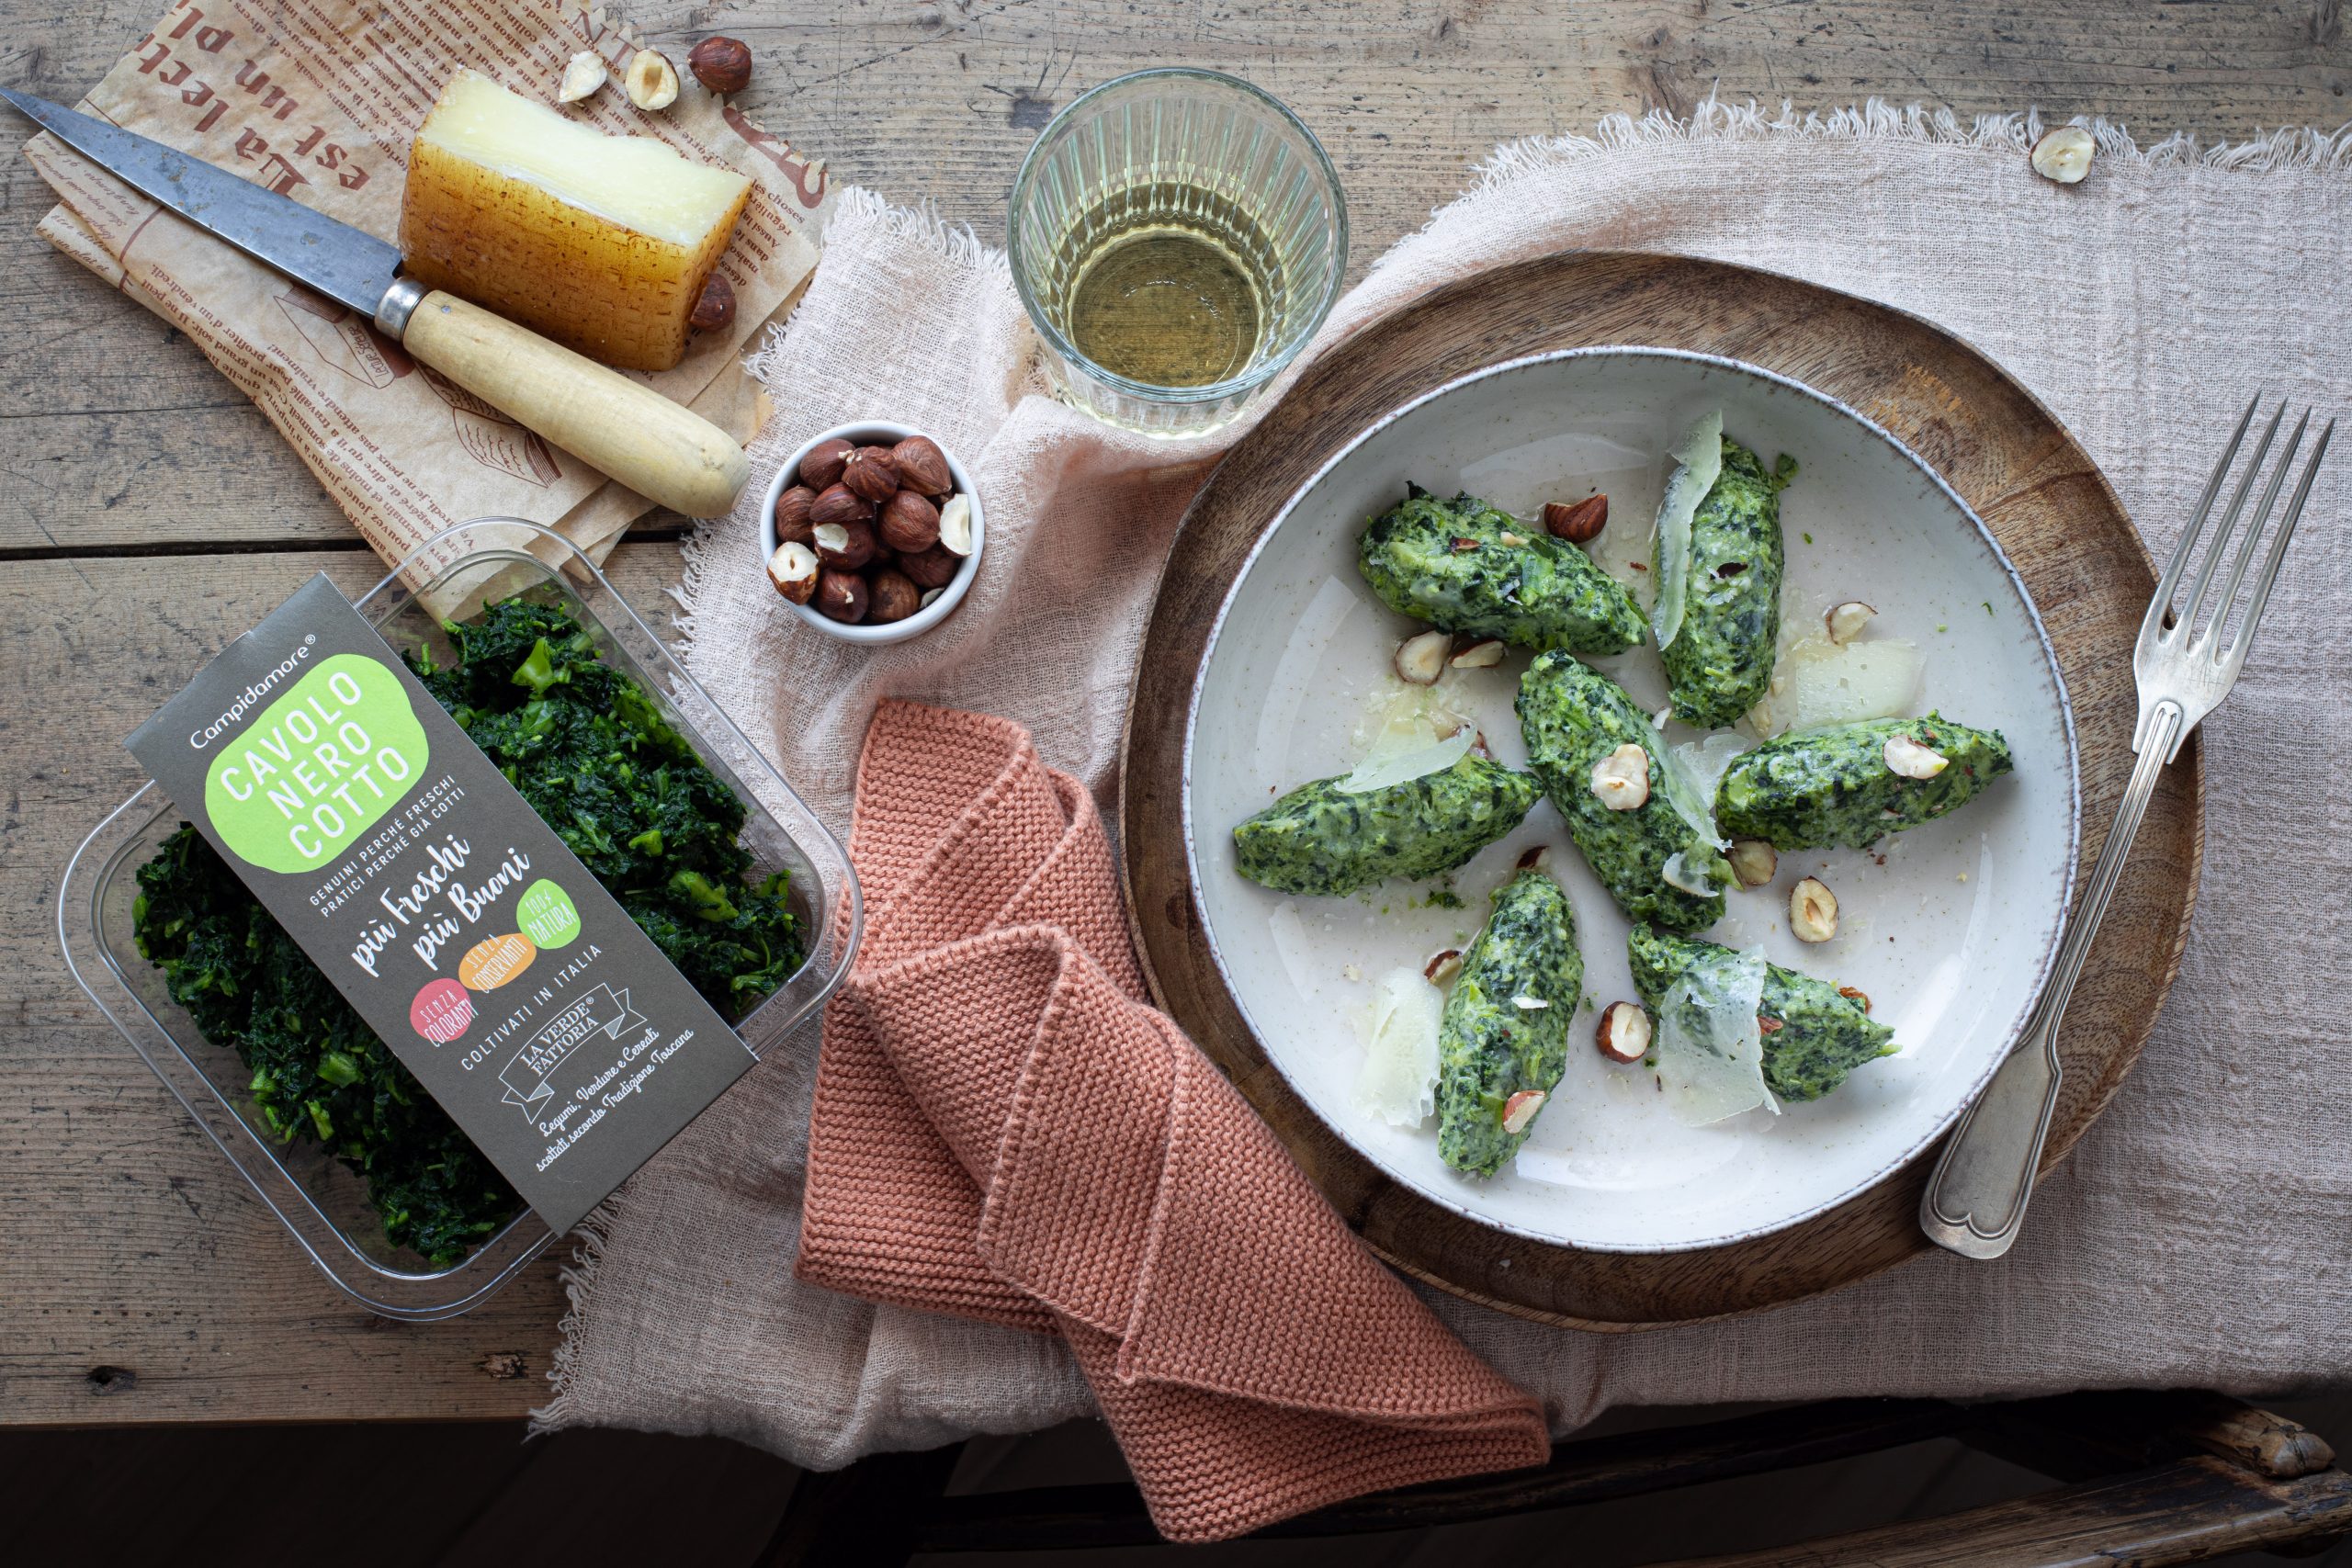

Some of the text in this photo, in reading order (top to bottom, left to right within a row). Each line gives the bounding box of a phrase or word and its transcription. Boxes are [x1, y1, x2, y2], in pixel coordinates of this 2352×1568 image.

[233, 2, 266, 34] divers
[300, 17, 322, 42] vous
[309, 4, 352, 46] moment
[356, 6, 396, 44] certain
[500, 4, 537, 43] colline,
[522, 6, 560, 40] monde
[266, 33, 280, 48] de
[274, 17, 314, 55] pouvez
[279, 46, 292, 59] et
[322, 39, 339, 56] de
[375, 1, 452, 75] et les animaux
[396, 44, 412, 60] un
[424, 3, 502, 80] Tout le monde
[480, 33, 518, 68] grosse
[492, 20, 532, 60] maison
[560, 39, 571, 53] le
[311, 53, 335, 79] vous
[351, 45, 367, 61] un
[532, 59, 549, 77] La
[134, 33, 230, 132] lect
[337, 55, 370, 87] temps
[337, 78, 352, 93] où
[366, 61, 402, 93] passer
[516, 68, 537, 89] une
[165, 0, 370, 191] est un pl
[326, 88, 367, 130] romans,
[352, 93, 365, 107] là
[369, 86, 381, 99] le
[363, 104, 389, 127] c'est
[593, 96, 629, 129] sur le
[623, 101, 662, 138] renard
[234, 125, 311, 198] La
[682, 131, 715, 164] Porte
[750, 178, 806, 224] les choses
[55, 239, 71, 251] un
[734, 229, 769, 262] dans le
[748, 221, 778, 248] Aussi
[138, 278, 167, 305] peut
[151, 264, 198, 309] vendredi.
[164, 300, 179, 314] ne
[198, 307, 223, 329] d'un
[191, 321, 214, 343] soir.
[222, 328, 267, 367] profiter
[214, 340, 250, 368] grand
[266, 344, 317, 390] vraiment!
[222, 364, 261, 390] quelle
[250, 367, 266, 379] un
[263, 362, 293, 386] pour
[265, 375, 288, 405] C'est
[258, 389, 303, 444] n'importe
[288, 385, 331, 429] travaillé
[317, 391, 360, 434] attendre
[288, 403, 325, 447] sommeil.
[330, 428, 340, 437] a
[326, 449, 341, 463] de
[336, 436, 364, 462] qu'il
[357, 434, 380, 454] pas
[303, 444, 343, 486] jusqu'à
[339, 461, 373, 492] moins
[364, 462, 387, 483] dire
[376, 453, 405, 478] peux
[340, 485, 373, 515] jouer
[370, 491, 383, 502] et
[386, 483, 401, 497] de
[401, 478, 417, 491] ne
[415, 490, 431, 502] je
[370, 513, 412, 552] pouvez
[398, 497, 442, 536] exagéré
[220, 671, 363, 801] CAVOLO
[266, 720, 372, 819] NERO
[288, 746, 410, 859] COTTO
[309, 774, 455, 906] GENUINI PERCHÉ FRESCHI
[320, 787, 465, 918] PRATICI PERCHÉ GIÀ COTTI
[351, 834, 470, 977] più Freschi
[412, 847, 530, 972] più Buoni
[527, 900, 577, 945] NATURA
[465, 933, 502, 969] SENZA
[471, 936, 527, 994] CONSERVANTI
[419, 989, 458, 1023] SENZA
[424, 998, 479, 1047] COLORANTI
[460, 944, 602, 1071] COLTIVATI IN ITALIA
[520, 1044, 545, 1067] LA
[530, 1016, 599, 1077] FATTORIA
[538, 1027, 660, 1138] Legumi, Verdure e Cereali
[536, 1029, 695, 1172] scottati secondo Tradizione Toscana
